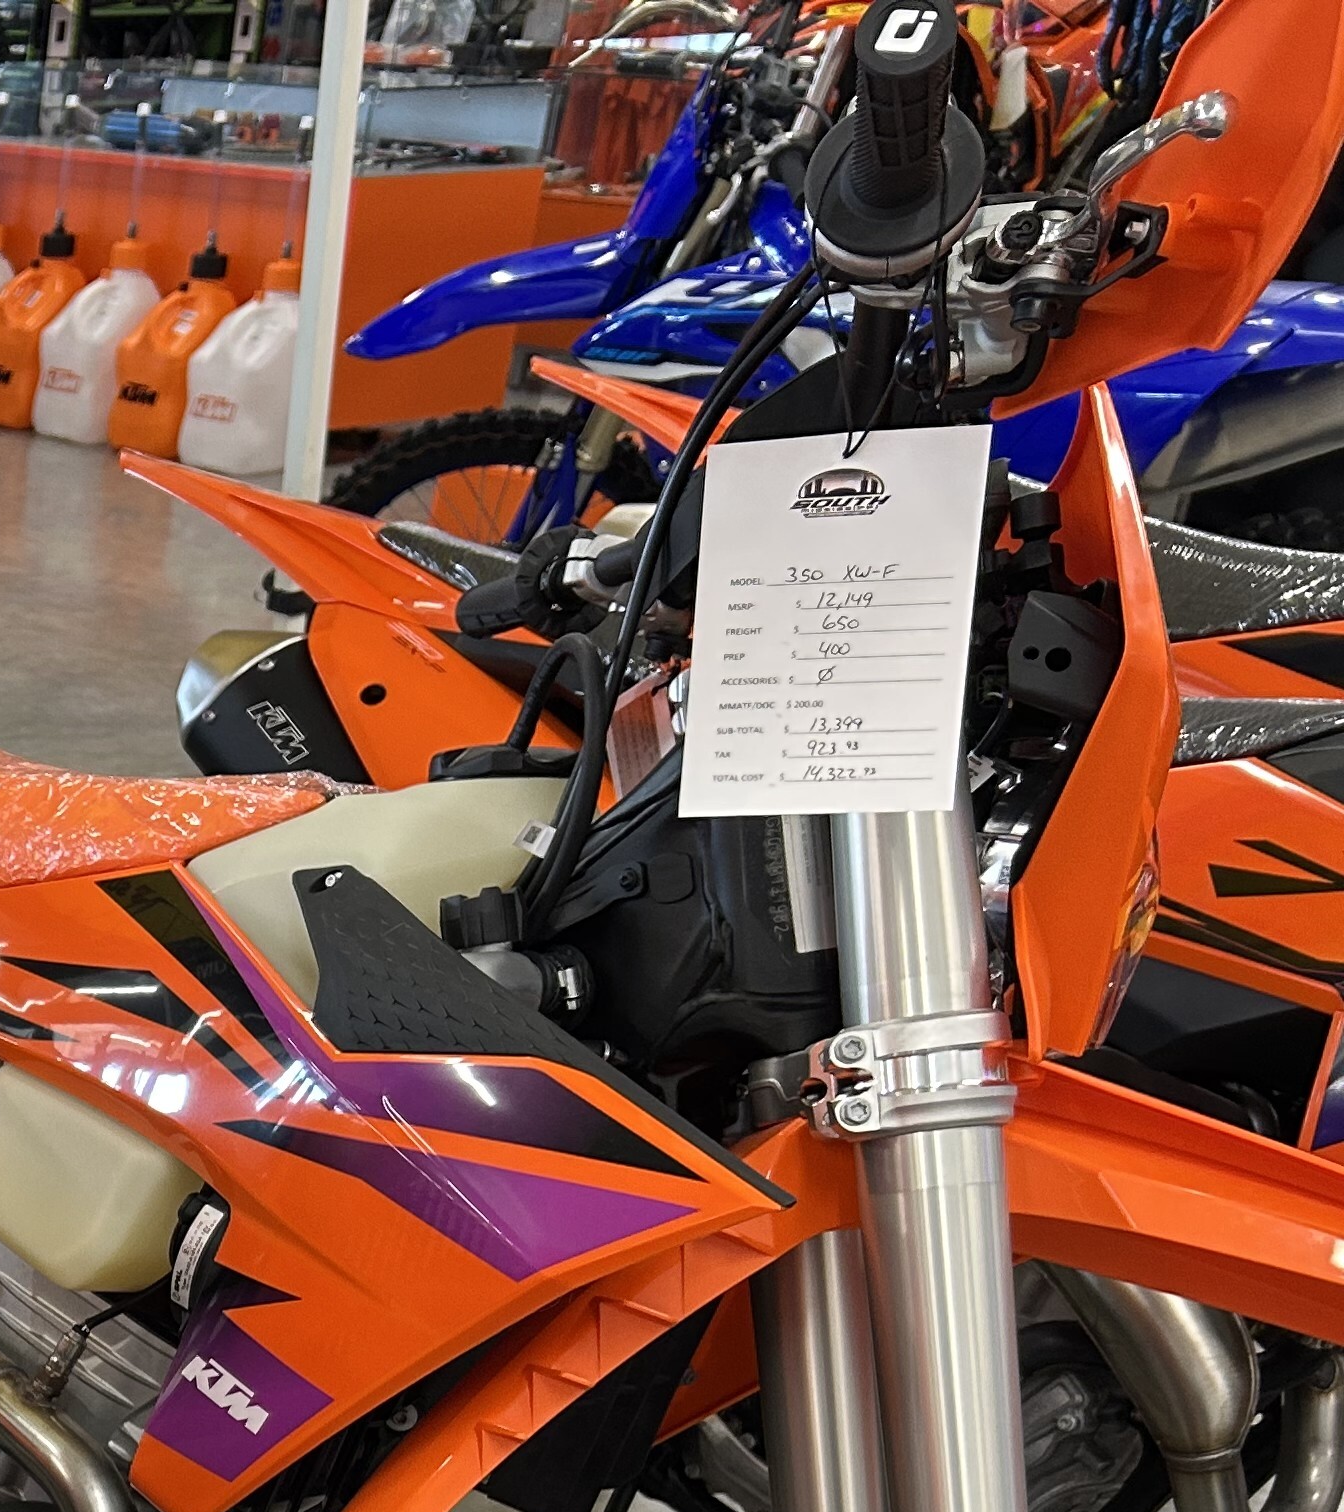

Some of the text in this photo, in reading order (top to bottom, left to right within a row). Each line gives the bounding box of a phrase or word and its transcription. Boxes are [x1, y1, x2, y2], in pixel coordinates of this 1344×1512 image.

[790, 494, 891, 510] SOUTH
[785, 566, 824, 583] 350
[843, 563, 900, 582] XW-F
[816, 592, 873, 611] 12,149
[725, 627, 763, 636] FREIGHT
[821, 614, 860, 631] 650
[723, 653, 746, 661] PREP
[818, 641, 850, 660] 400
[246, 700, 310, 766] KTM
[716, 727, 764, 735] SUB-TOTAL
[809, 716, 863, 735] 13,399
[714, 751, 731, 759] TAX
[712, 774, 739, 782] TOTAL
[741, 773, 764, 782] COST
[180, 1354, 270, 1436] KTM
